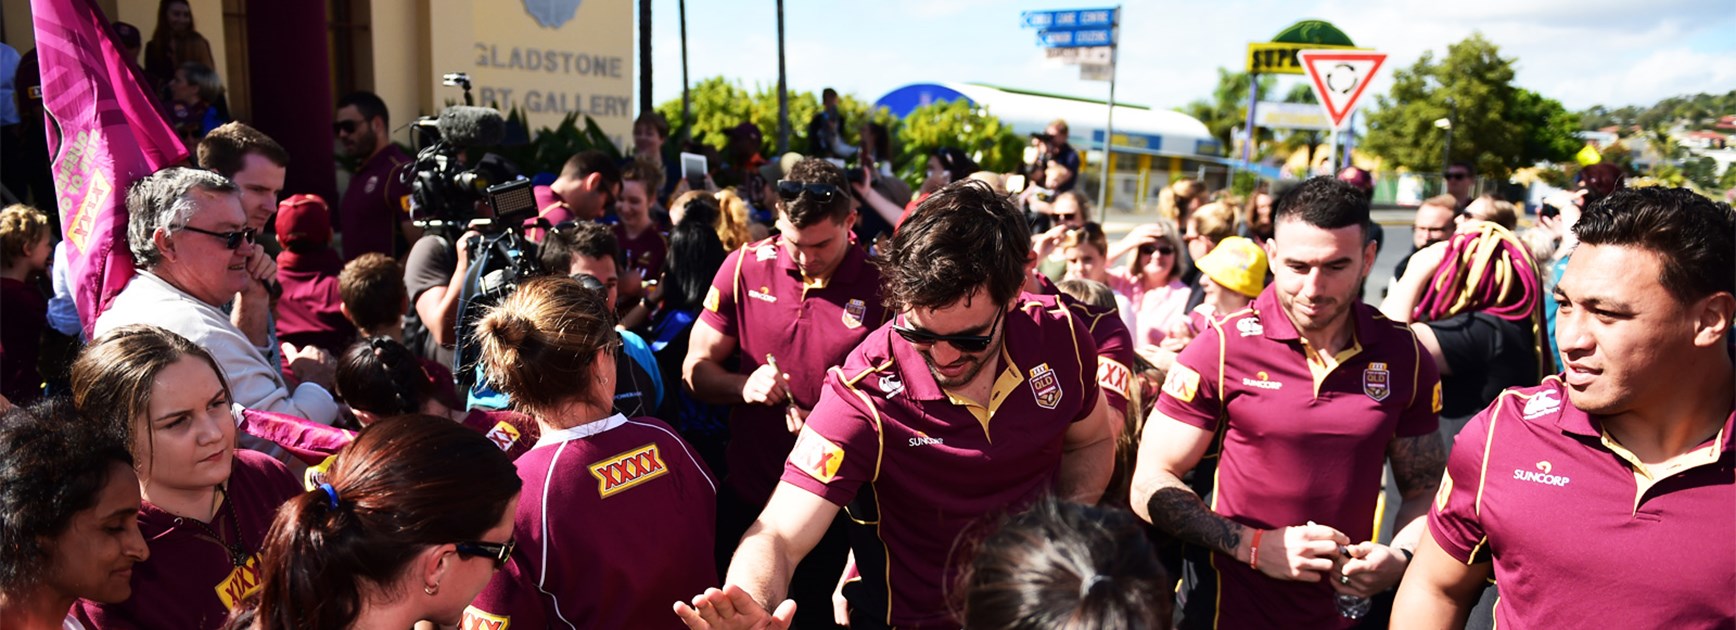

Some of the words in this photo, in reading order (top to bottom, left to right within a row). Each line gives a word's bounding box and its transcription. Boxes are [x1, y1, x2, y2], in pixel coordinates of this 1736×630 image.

[475, 43, 622, 78] GLADSTONE
[480, 87, 512, 110] RT
[524, 90, 630, 118] GALLERY
[1035, 376, 1053, 390] QLD
[1242, 377, 1283, 390] SUNCORP
[597, 449, 662, 490] XXXX
[1513, 469, 1570, 486] SUNCORP
[225, 562, 261, 607] XXX
